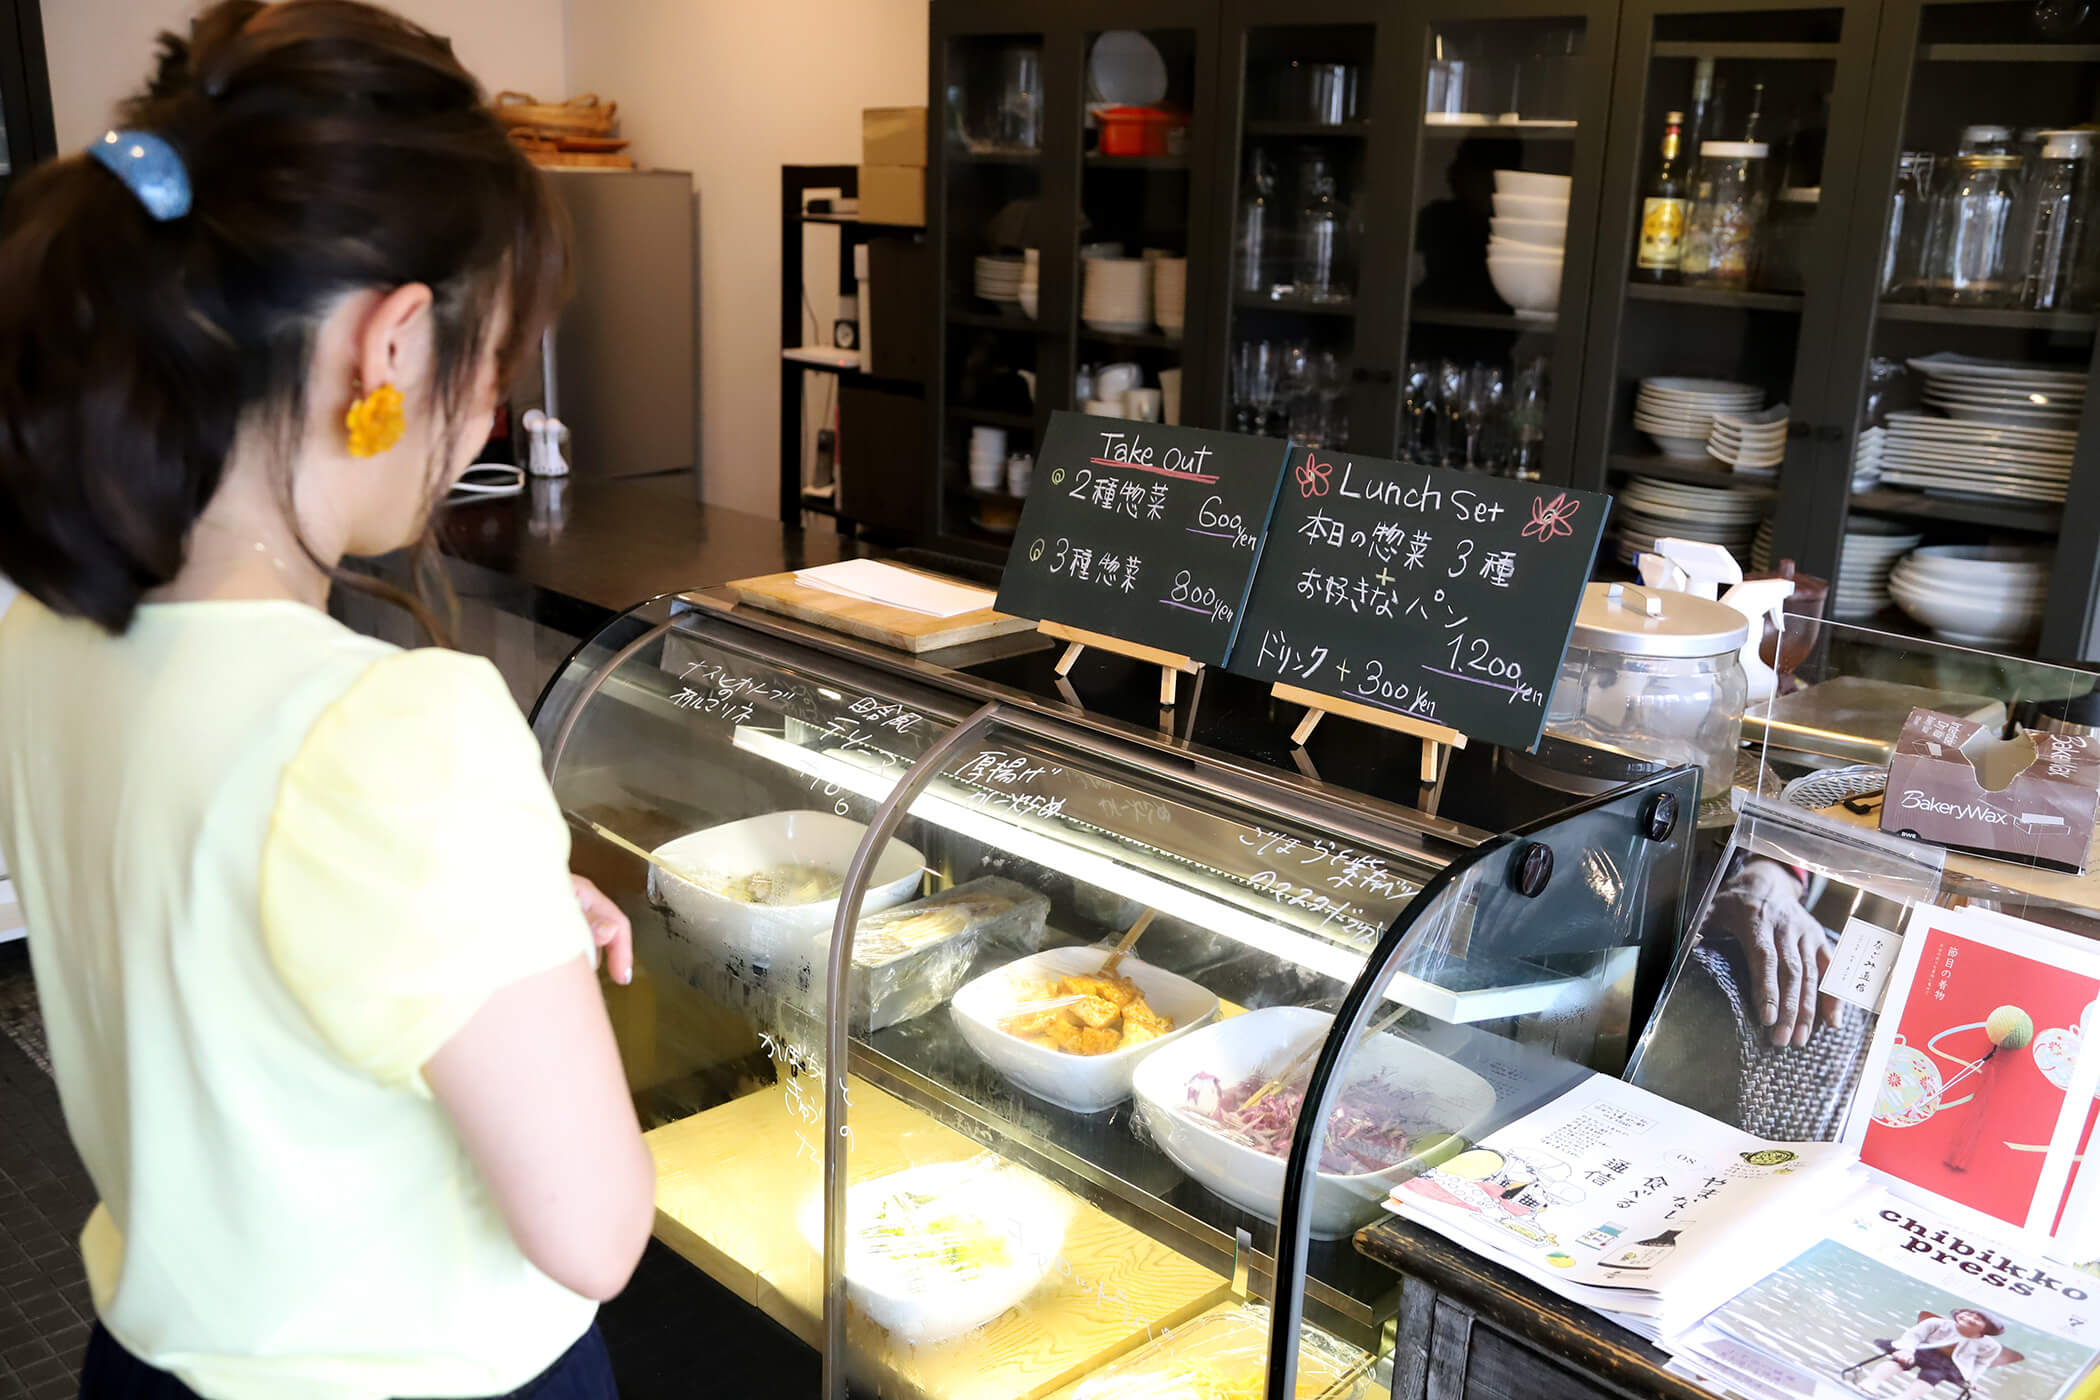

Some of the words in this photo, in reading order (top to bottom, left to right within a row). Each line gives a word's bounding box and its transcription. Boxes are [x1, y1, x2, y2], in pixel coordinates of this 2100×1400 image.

[1100, 432, 1153, 467] Take
[1163, 445, 1213, 474] Out
[1339, 461, 1441, 512] Lunch
[1451, 489, 1504, 522] Set
[1257, 630, 1328, 679] ドリンク
[1901, 790, 2008, 826] BakeryWax
[1878, 1209, 2089, 1301] chibikko
[1900, 1235, 2036, 1297] press
